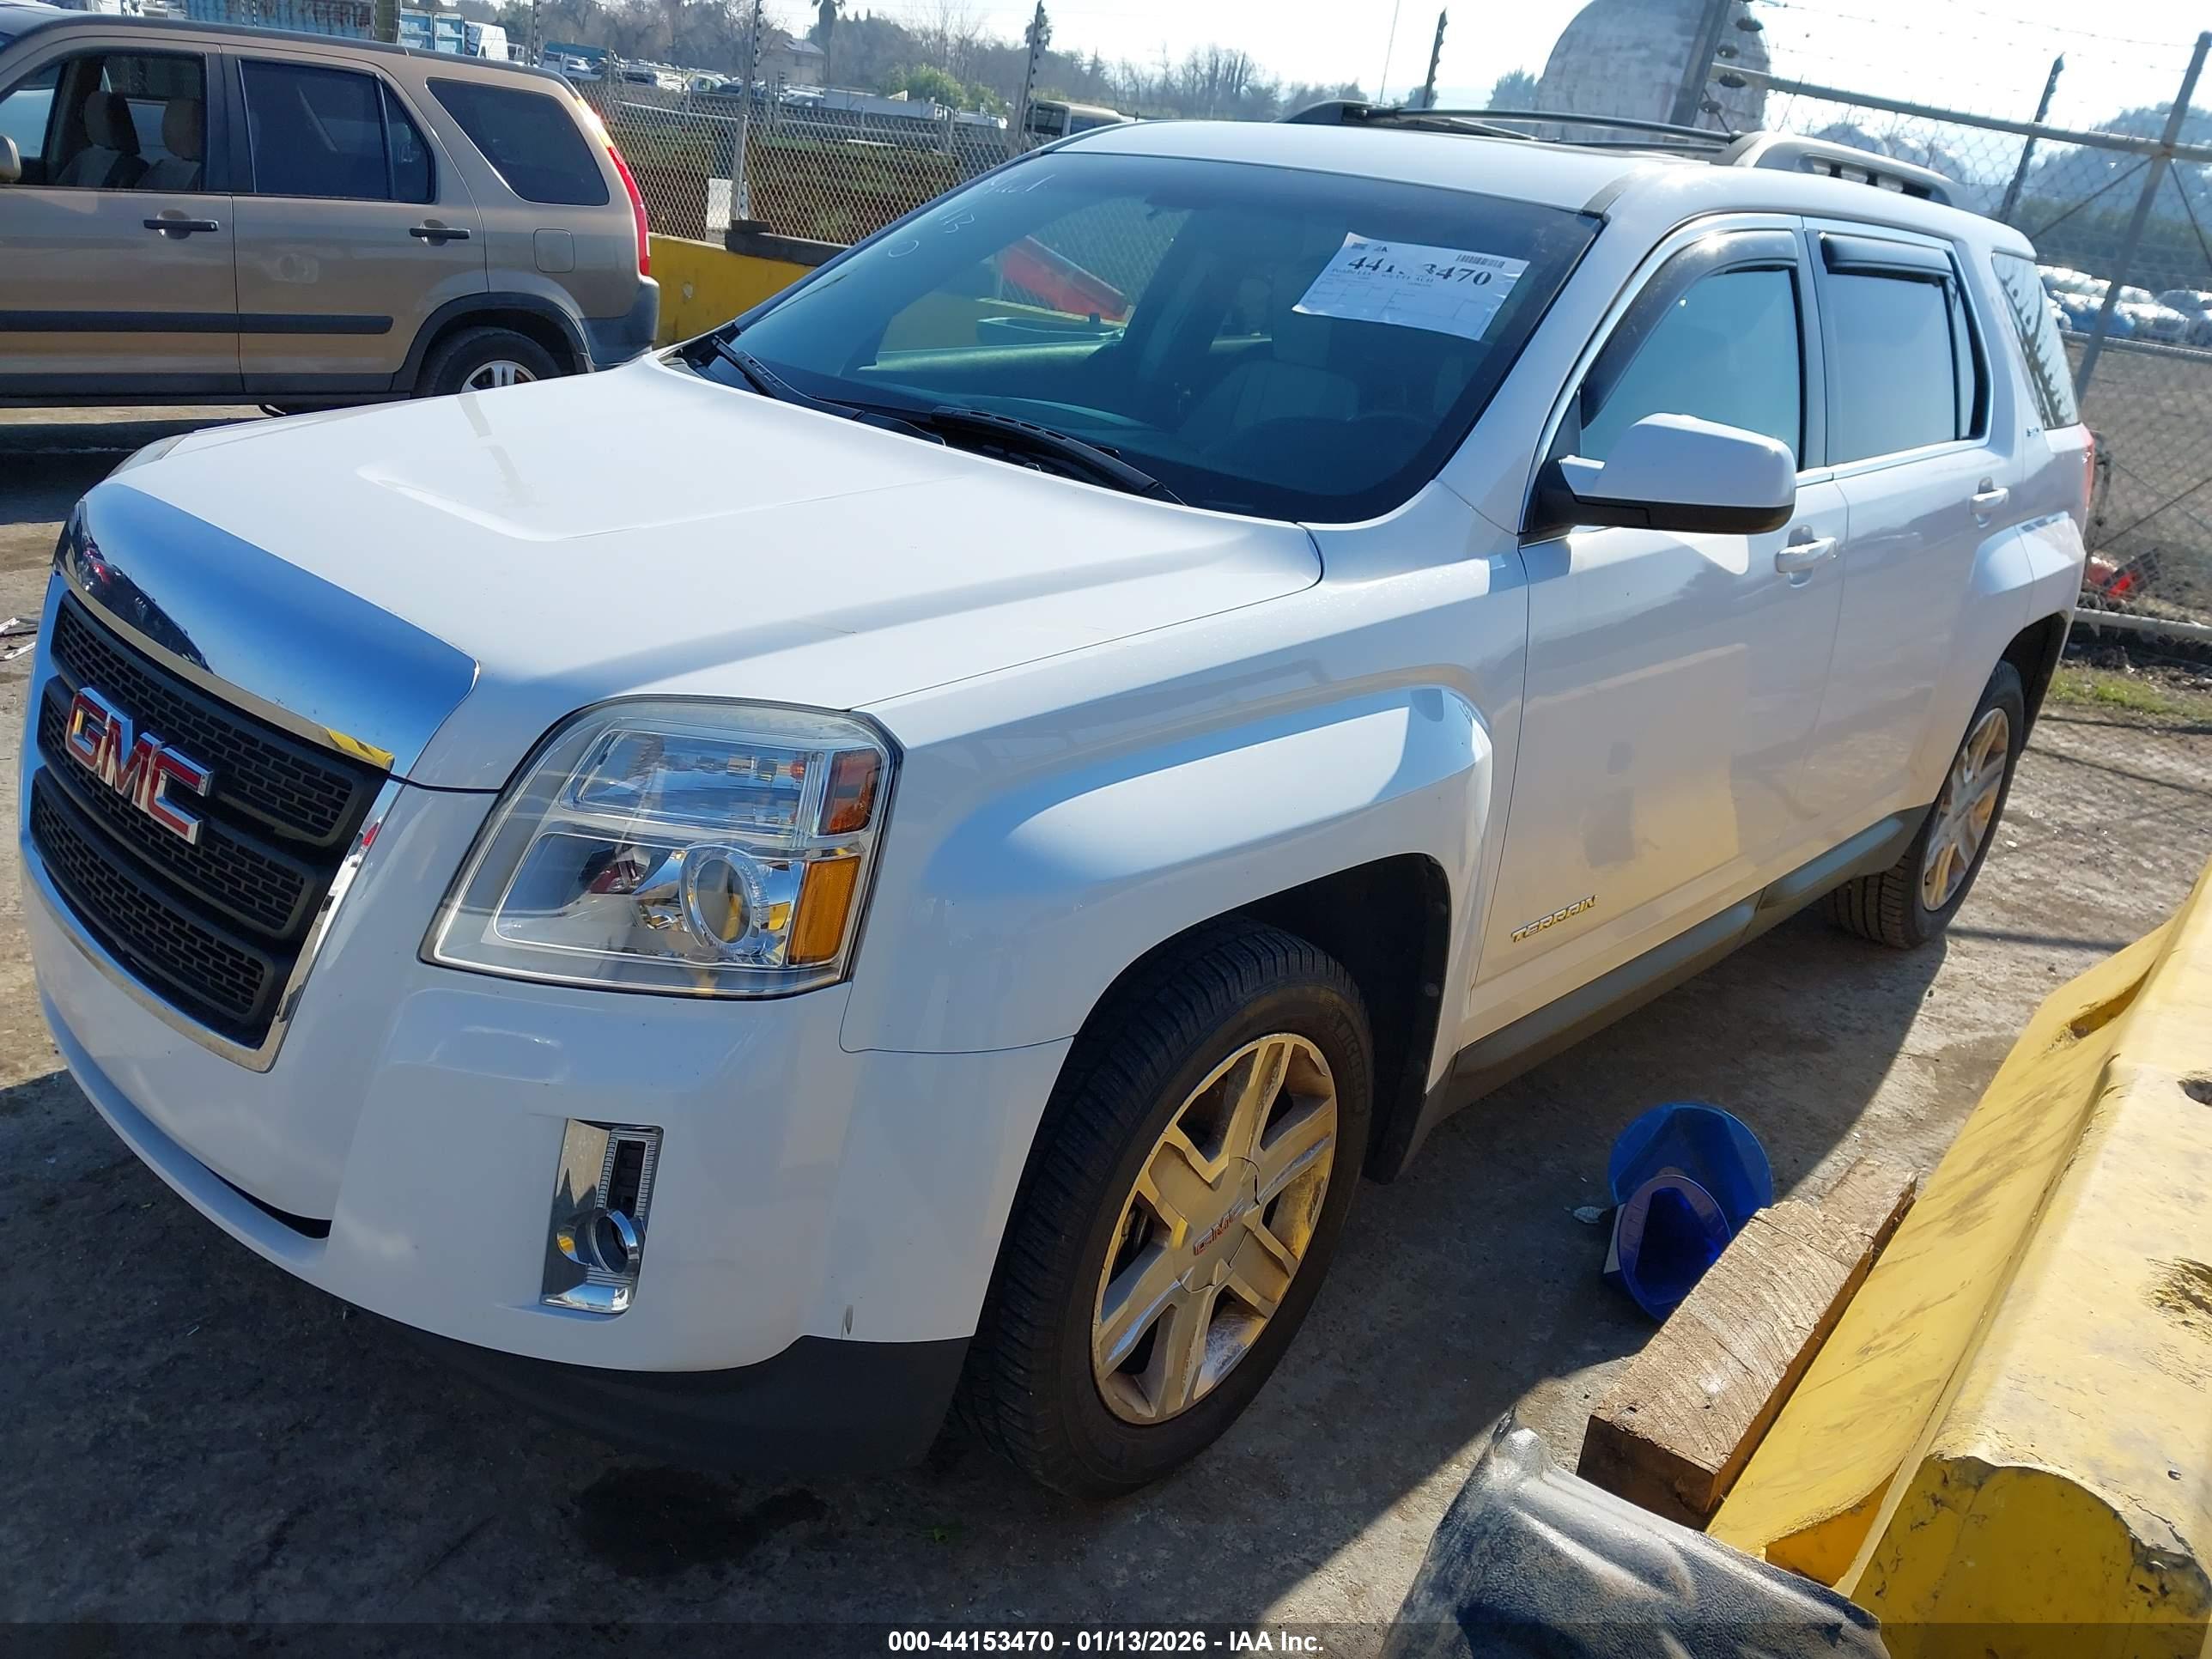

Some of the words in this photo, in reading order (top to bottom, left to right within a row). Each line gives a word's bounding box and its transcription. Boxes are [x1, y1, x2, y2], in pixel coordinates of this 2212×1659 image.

[65, 686, 214, 845] GMC
[1510, 895, 1599, 943] TERRAIN
[1194, 1197, 1244, 1256] GMC
